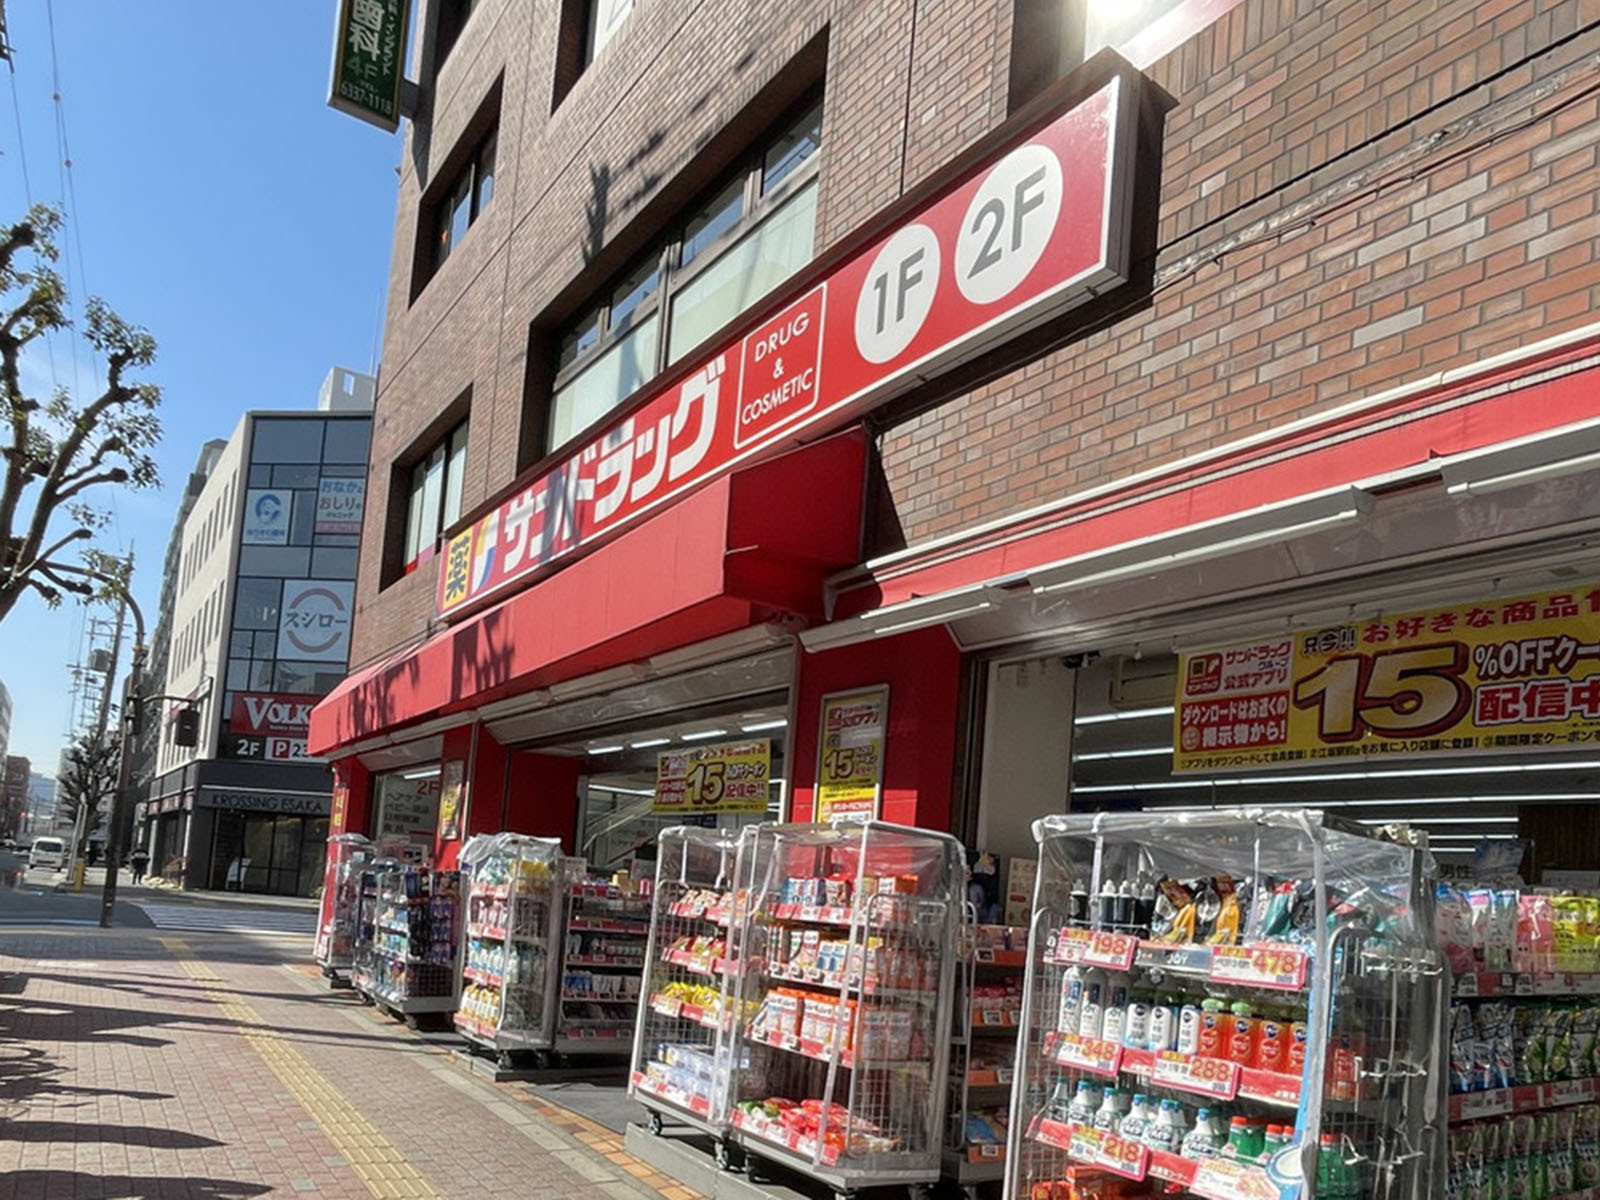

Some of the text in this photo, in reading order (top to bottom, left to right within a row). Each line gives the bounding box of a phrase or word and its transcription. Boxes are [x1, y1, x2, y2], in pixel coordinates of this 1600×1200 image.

[967, 164, 1047, 280] 2F
[873, 247, 925, 335] 1F
[754, 312, 810, 362] DRUG
[773, 357, 785, 379] &
[741, 368, 813, 425] COSMETIC
[503, 354, 726, 573] サンドラッグ
[284, 612, 347, 629] スシロー
[1293, 640, 1472, 743] 15
[1182, 695, 1288, 726] ダウンロードはお近くの
[237, 739, 260, 756] 2F
[275, 741, 287, 756] P
[825, 748, 855, 780] 15
[417, 780, 439, 796] 2F
[687, 761, 726, 805] 15
[1093, 935, 1126, 955] 198
[1253, 951, 1296, 974] 478
[1081, 1039, 1114, 1060] 348
[1190, 1058, 1229, 1081] 288
[1103, 1135, 1139, 1162] 218
